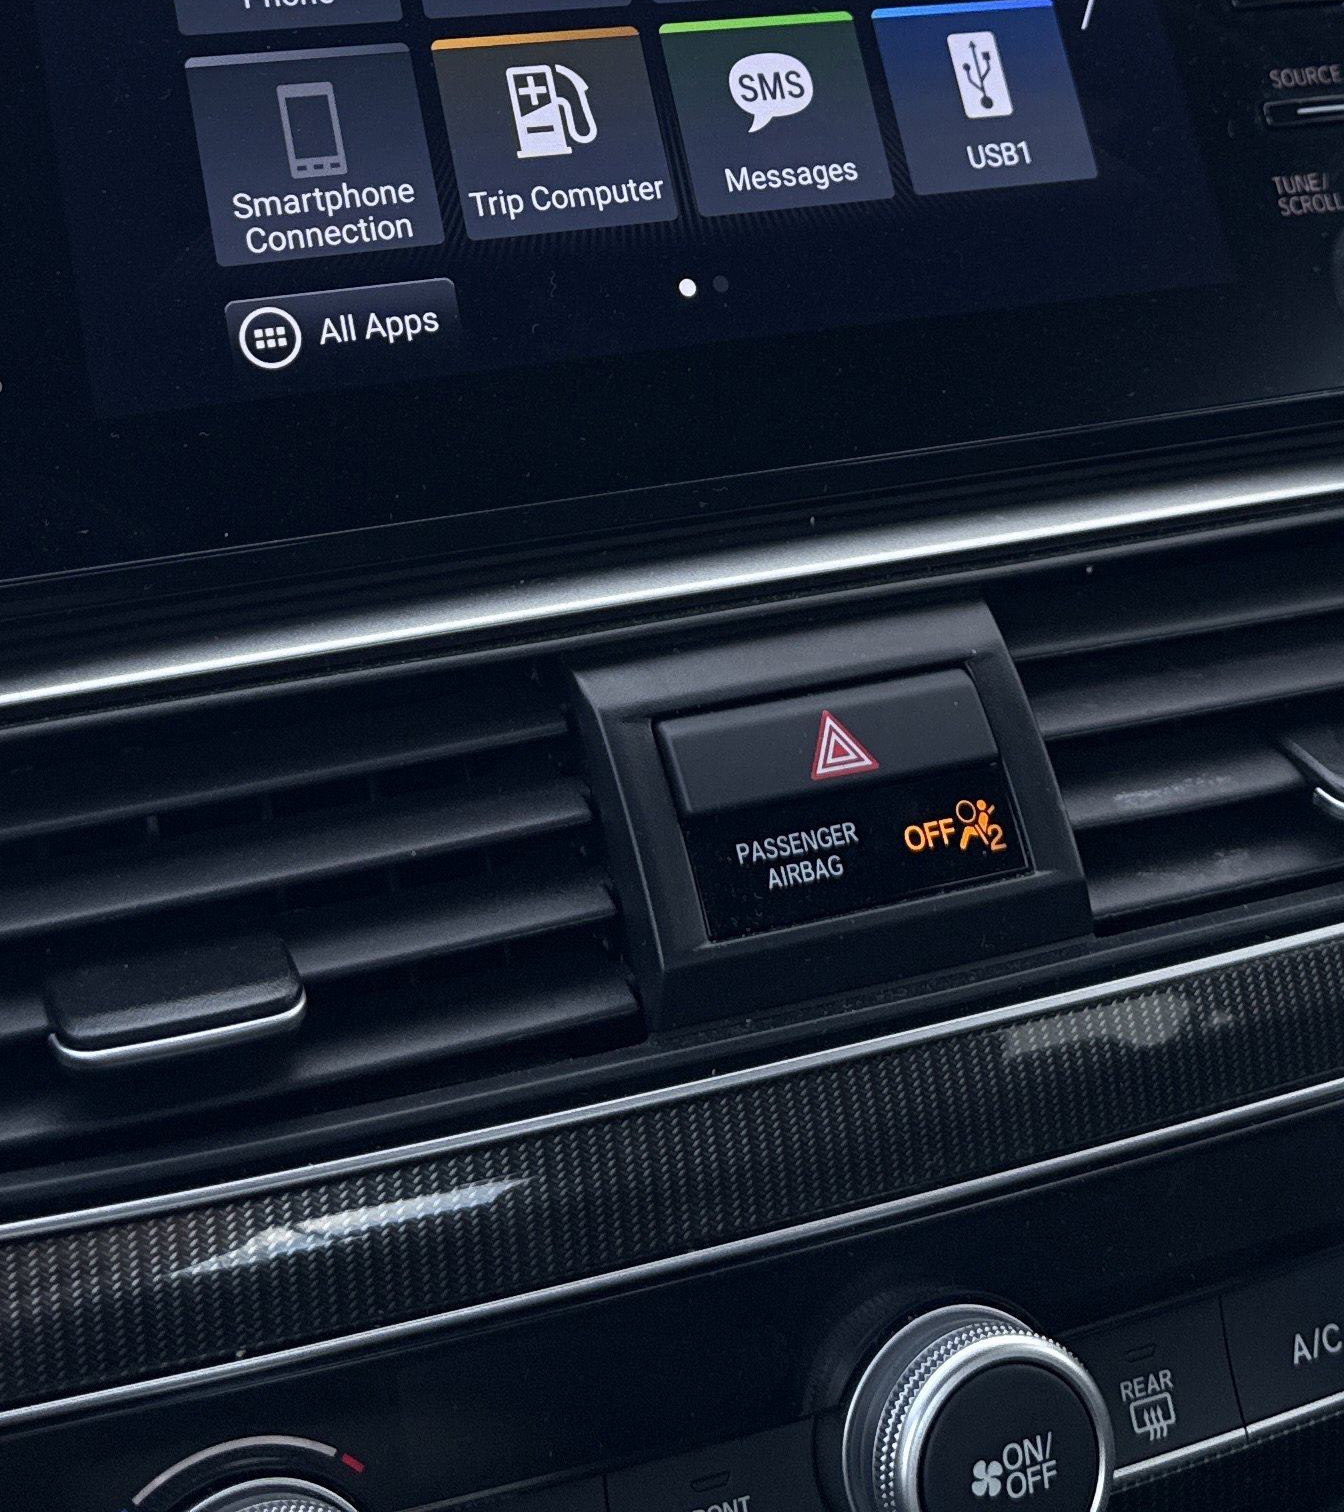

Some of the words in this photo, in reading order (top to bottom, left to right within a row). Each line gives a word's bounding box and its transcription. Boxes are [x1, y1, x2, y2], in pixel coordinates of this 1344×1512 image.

[738, 69, 806, 103] SMS
[1269, 65, 1343, 89] SOURCE
[966, 141, 1033, 170] USB1
[725, 160, 858, 193] Messages
[1272, 172, 1329, 195] TUNE/
[232, 182, 415, 220] Smartphone
[468, 189, 525, 220] Trip
[531, 178, 664, 216] Computer
[1278, 192, 1344, 217] SCROLL
[246, 215, 414, 254] Connection
[319, 313, 357, 345] All
[365, 311, 439, 344] Apps
[735, 822, 859, 866] PASSENGER
[904, 818, 955, 851] OFF
[768, 855, 844, 890] AIRBAG
[1292, 1323, 1343, 1366] A/C
[1119, 1369, 1173, 1402] REAR
[1002, 1431, 1052, 1470] ON/
[1006, 1459, 1057, 1499] OFF
